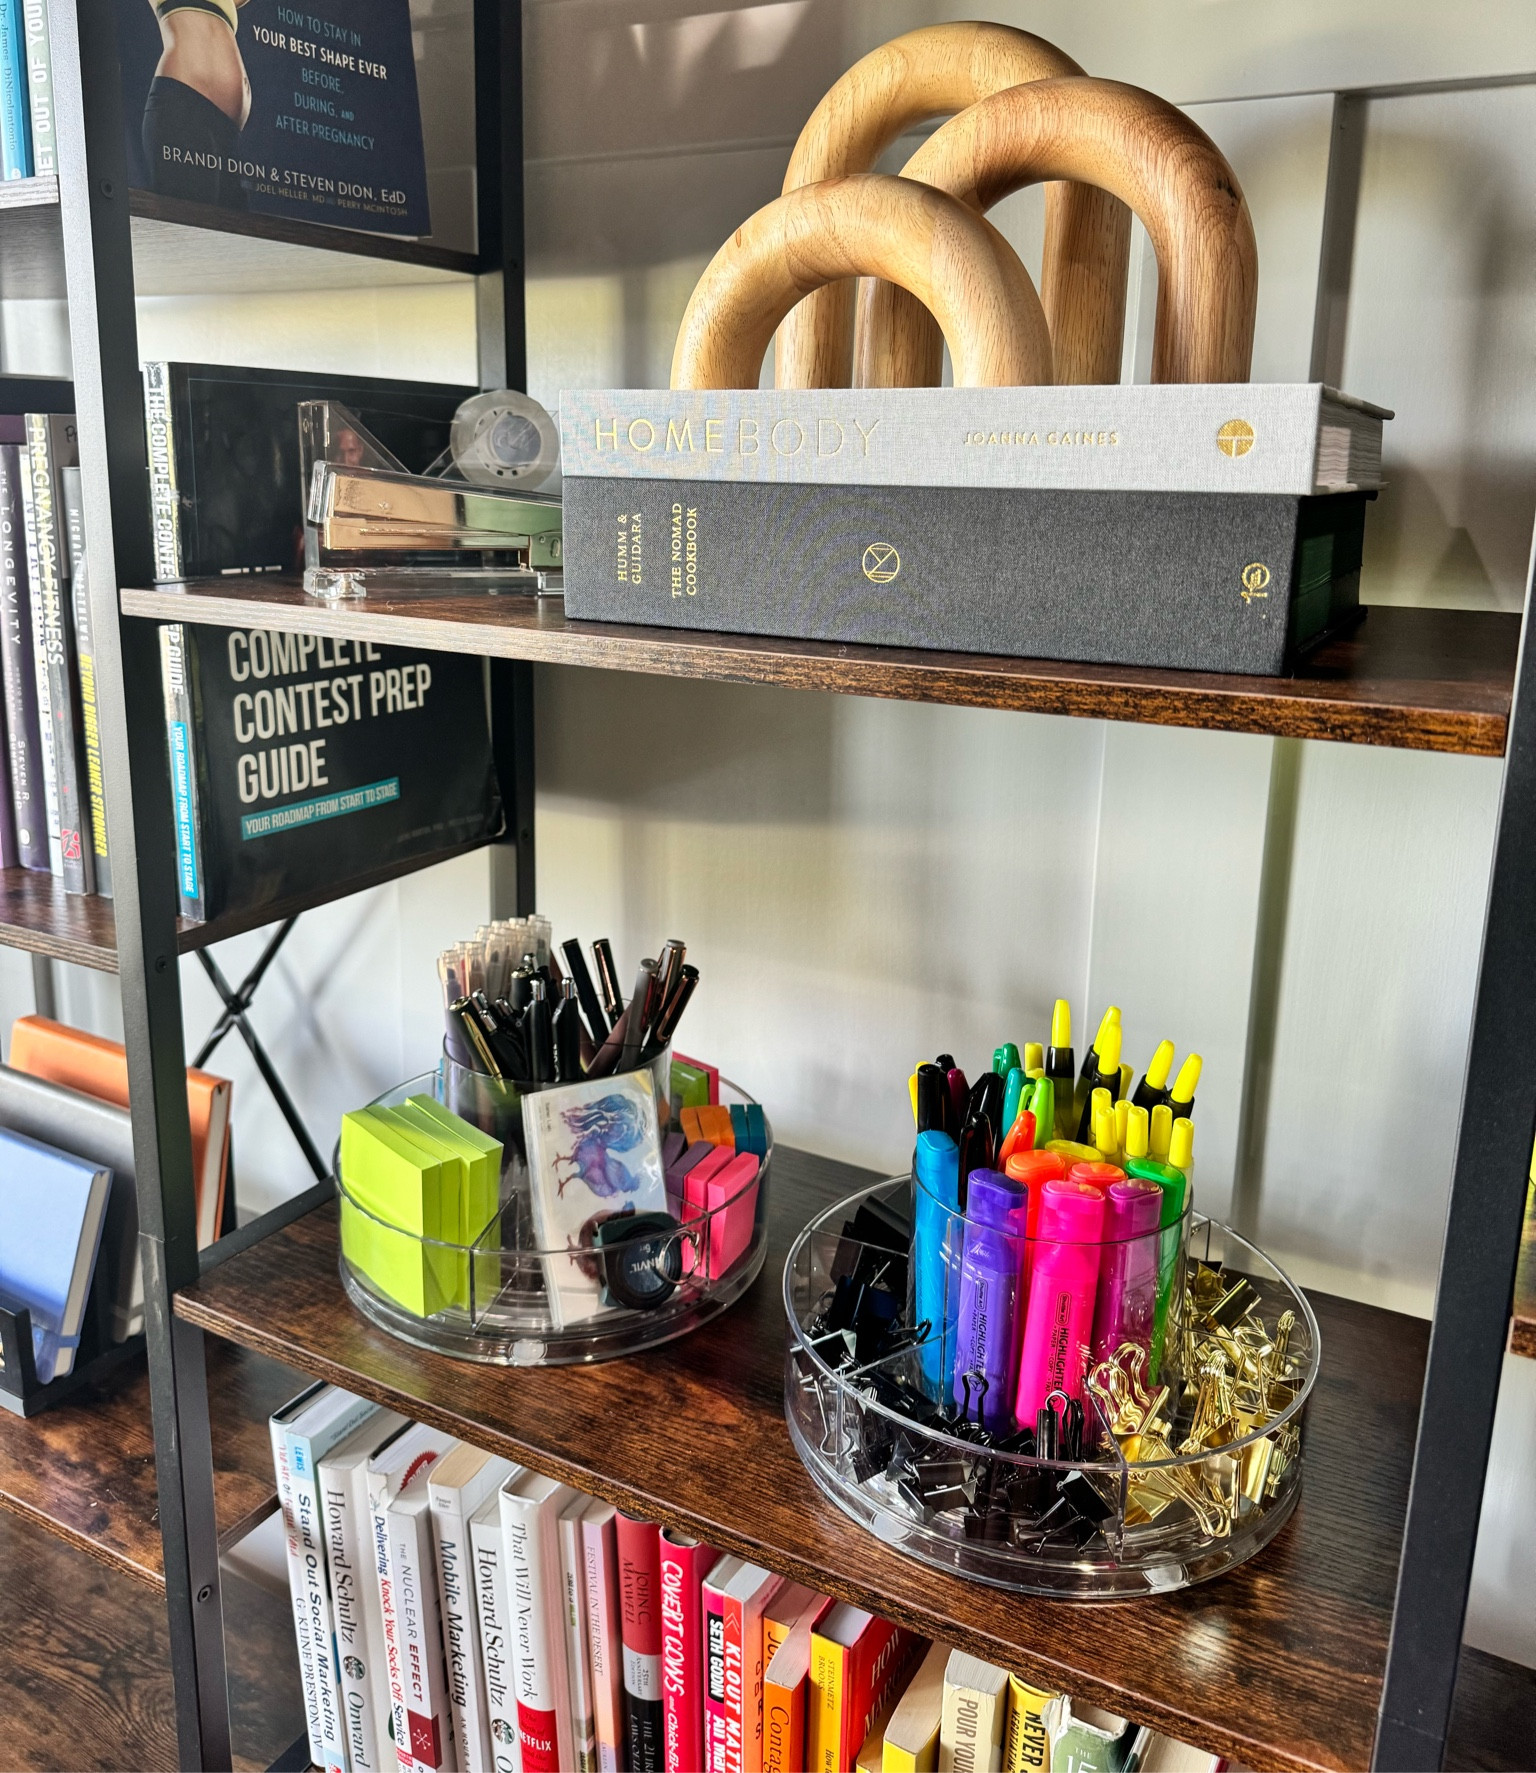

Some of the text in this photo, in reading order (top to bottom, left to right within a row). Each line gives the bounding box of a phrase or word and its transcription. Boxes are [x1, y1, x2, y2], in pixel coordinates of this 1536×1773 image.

[1, 24, 9, 61] James
[278, 5, 361, 46] HOW TO STAY IN
[32, 57, 48, 84] OF
[253, 25, 387, 80] YOUR BEST SHAPE EVER
[3, 67, 16, 151] DiNicolantonio
[34, 93, 51, 133] OUT
[295, 92, 354, 121] DURING, AND
[276, 115, 375, 150] AFTER PREGNANCY
[163, 145, 406, 205] BRANDI DION & STEVEN DION, EdD
[256, 183, 276, 195] JOEL
[312, 195, 325, 205] MD
[337, 199, 361, 211] PERRY
[149, 387, 165, 422] THE
[963, 430, 1120, 446] JOANNA GAINES
[151, 423, 171, 516] COMPLETE
[29, 426, 56, 573] PREGNANCY
[44, 576, 64, 666] FITNESS
[617, 513, 627, 581] HUMM &
[631, 513, 642, 584] GUIDARA
[672, 503, 682, 598] THE NOMAD
[686, 506, 698, 596] COOKBOOK
[1, 506, 21, 645] LONGEVITY
[70, 508, 88, 642] MICHAEL MATTHEWS
[168, 646, 183, 695] GUIDE
[233, 663, 432, 743] CONTEST PREP
[17, 741, 27, 786] STEVEN
[80, 653, 107, 857] BEYOND BIGGER LEANER STRONGER
[237, 739, 329, 804] GUIDE
[15, 790, 23, 810] MD
[174, 726, 195, 892] YOUR ROADMAP FROM START TO STAGE
[246, 782, 398, 834] YOUR ROADMAP FROM START TO STAGE
[631, 1256, 661, 1273] ANVIL
[1050, 1329, 1058, 1348] PAPER
[294, 1446, 305, 1472] LEWIS
[374, 1516, 390, 1576] Delivering
[296, 1598, 305, 1612] G.
[381, 1578, 395, 1614] Knock
[512, 1522, 538, 1699] That Will Never Work
[587, 1546, 603, 1676] FESTIVAL IN THE DESERT
[623, 1558, 634, 1623] MAXWELL
[634, 1571, 651, 1625] JOHN C.
[661, 1560, 684, 1638] COVERT
[298, 1616, 313, 1660] KLINE
[299, 1494, 335, 1742] Stand Out Social Marketing
[326, 1490, 370, 1768] Howard Schultz Onward
[384, 1618, 396, 1643] Your
[399, 1543, 423, 1702] THE NUCLEAR EFFECT
[440, 1539, 468, 1707] Mobile Marketing
[478, 1546, 507, 1707] Howard Schultz
[386, 1644, 400, 1680] Socks
[664, 1635, 685, 1696] COWS
[709, 1619, 724, 1698] SETH GODIN
[726, 1641, 741, 1714] KLOUT
[818, 1655, 826, 1691] BROOKS
[391, 1682, 404, 1704] Off
[669, 1695, 677, 1713] and
[827, 1660, 835, 1711] STEINMETZ
[393, 1702, 406, 1746] Service
[630, 1714, 640, 1757] LAWS OF
[643, 1721, 655, 1755] THE 21
[712, 1714, 725, 1739] All
[956, 1697, 979, 1737] POUR
[1021, 1710, 1046, 1767] NEVER
[311, 1735, 323, 1750] IV
[462, 1734, 471, 1758] HOUR
[825, 1749, 834, 1767] How
[1075, 1747, 1092, 1759] THE
